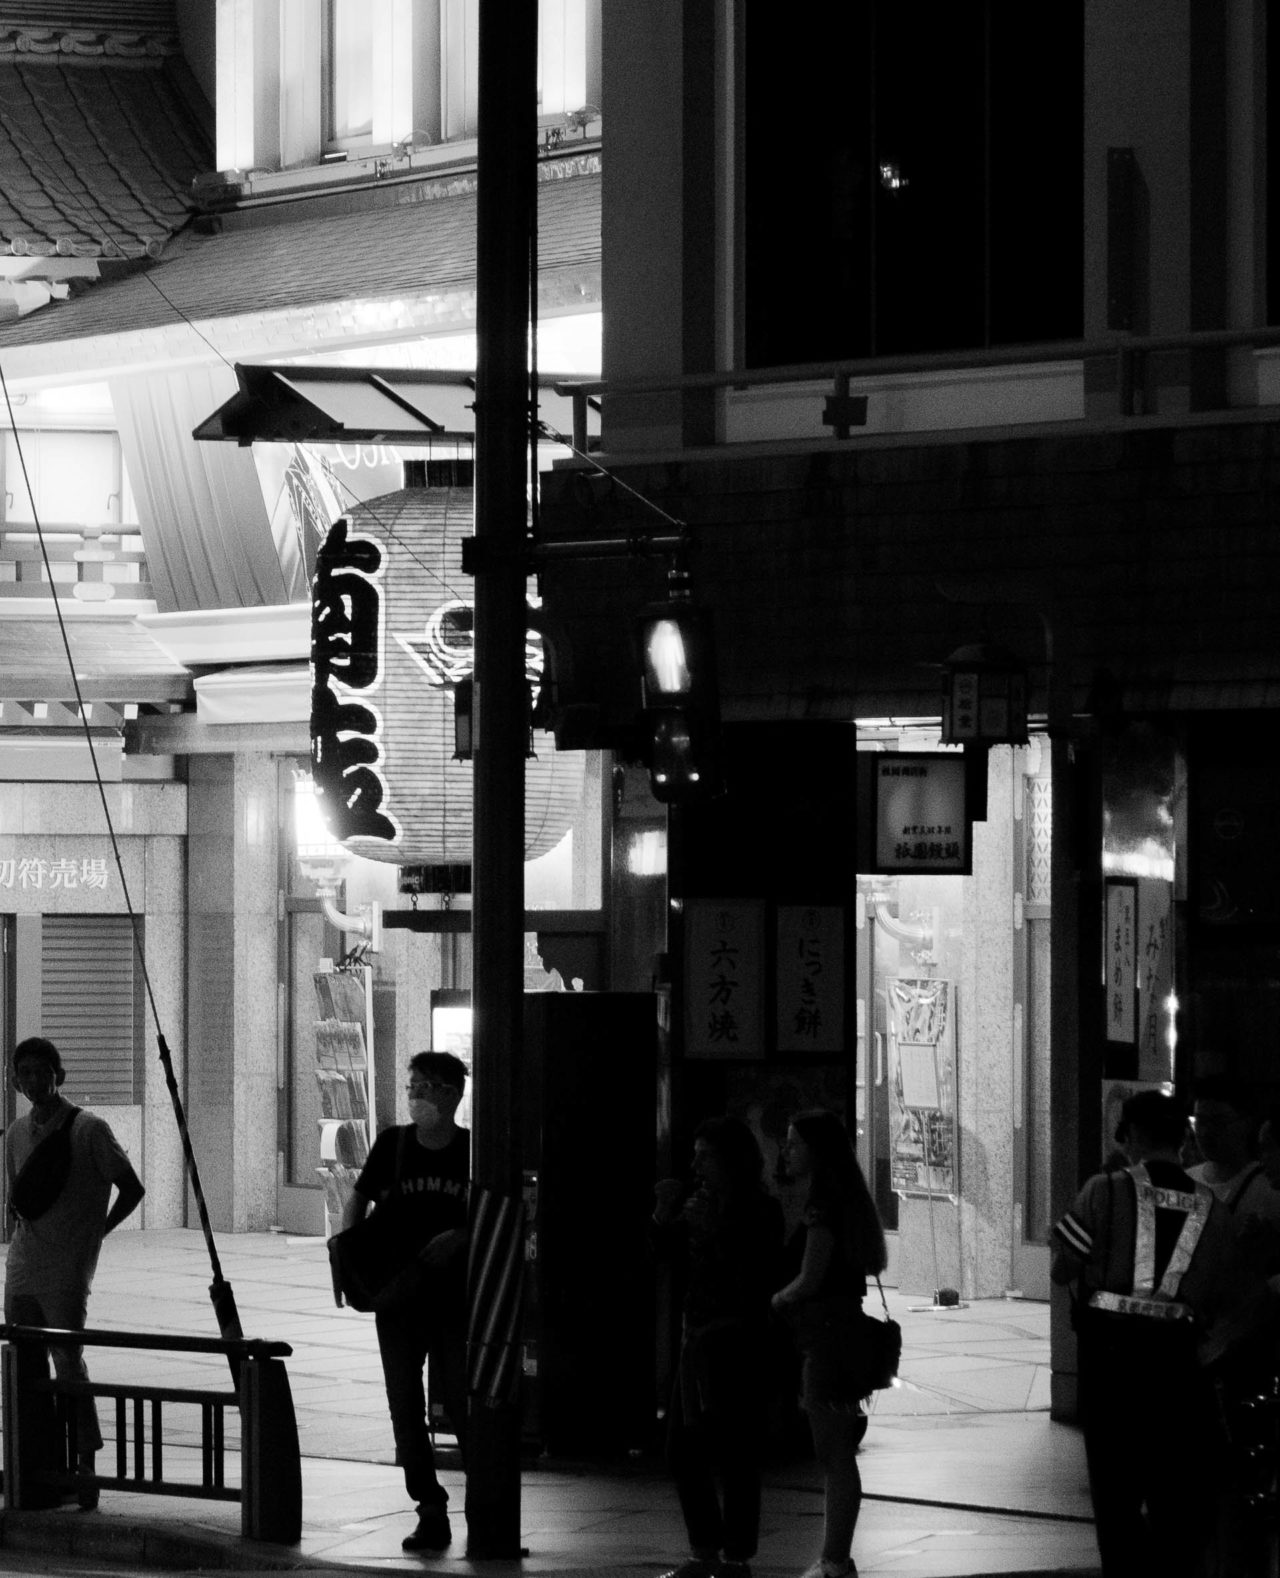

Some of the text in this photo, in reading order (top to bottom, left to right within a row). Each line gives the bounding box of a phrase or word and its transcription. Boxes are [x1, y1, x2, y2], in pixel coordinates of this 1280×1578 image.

[707, 939, 740, 1042] 六方焼
[1143, 1186, 1203, 1212] POLICE
